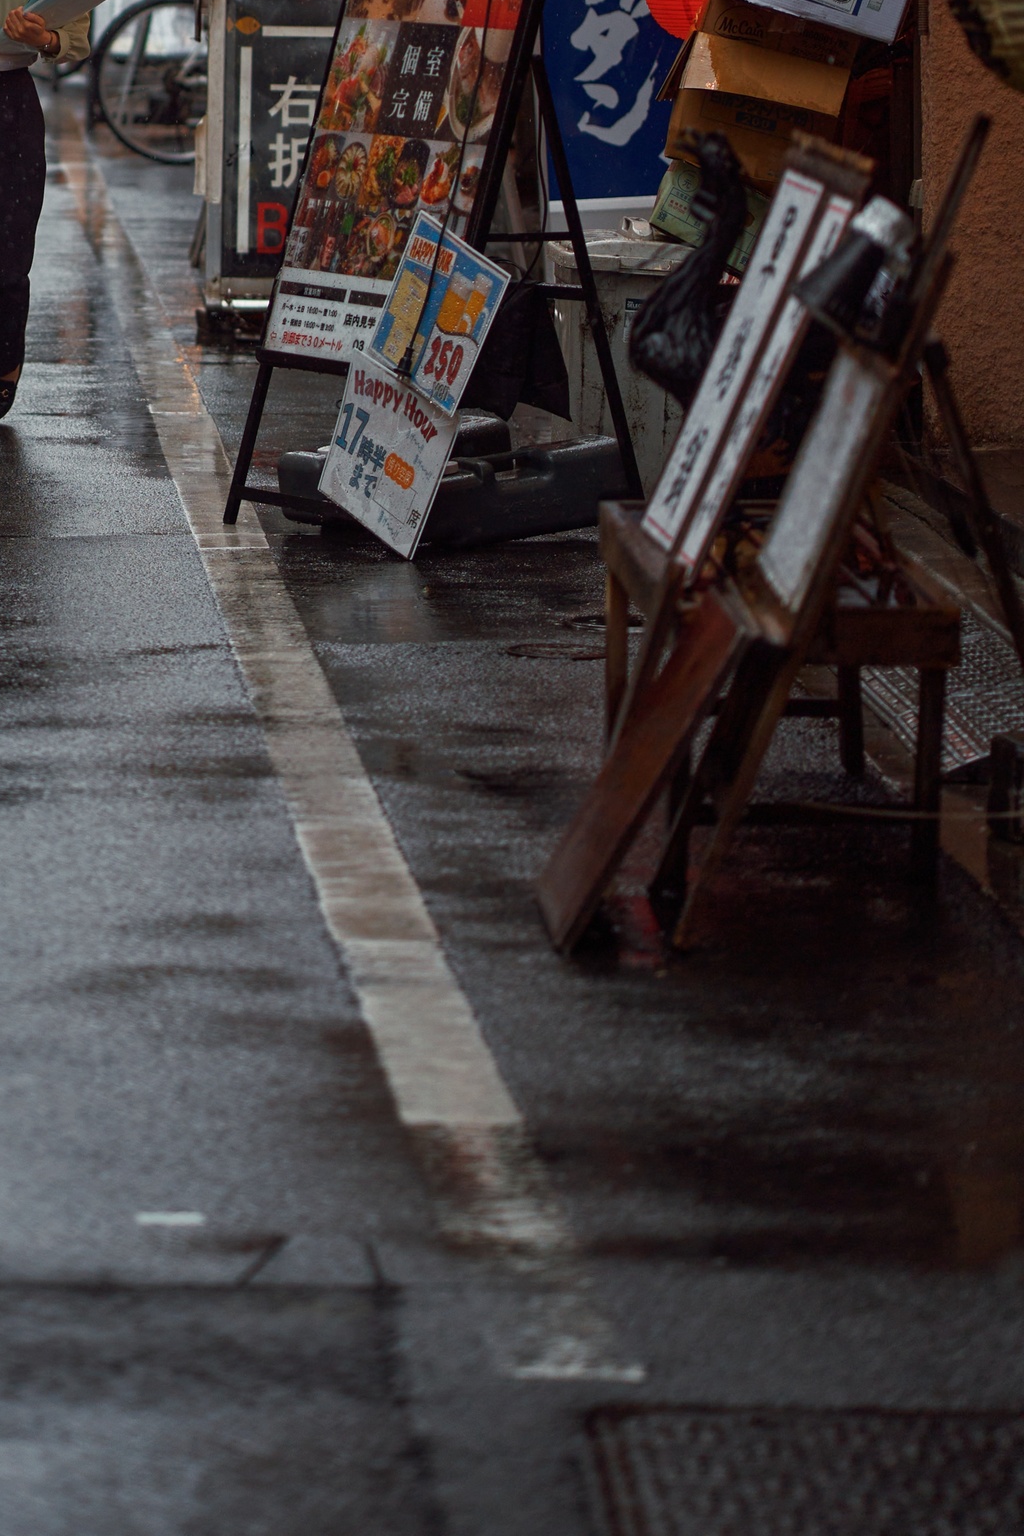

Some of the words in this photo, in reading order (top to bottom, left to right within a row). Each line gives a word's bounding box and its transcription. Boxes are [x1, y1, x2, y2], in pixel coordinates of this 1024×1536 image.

[717, 16, 766, 40] McCain
[400, 44, 445, 77] 個室
[388, 89, 434, 121] 完備
[256, 202, 289, 254] B
[409, 237, 436, 264] HAPPY
[343, 313, 376, 329] 店内見学
[423, 335, 464, 386] 250
[354, 369, 404, 413] Happy
[404, 392, 439, 443] Hour
[348, 464, 378, 498] まで
